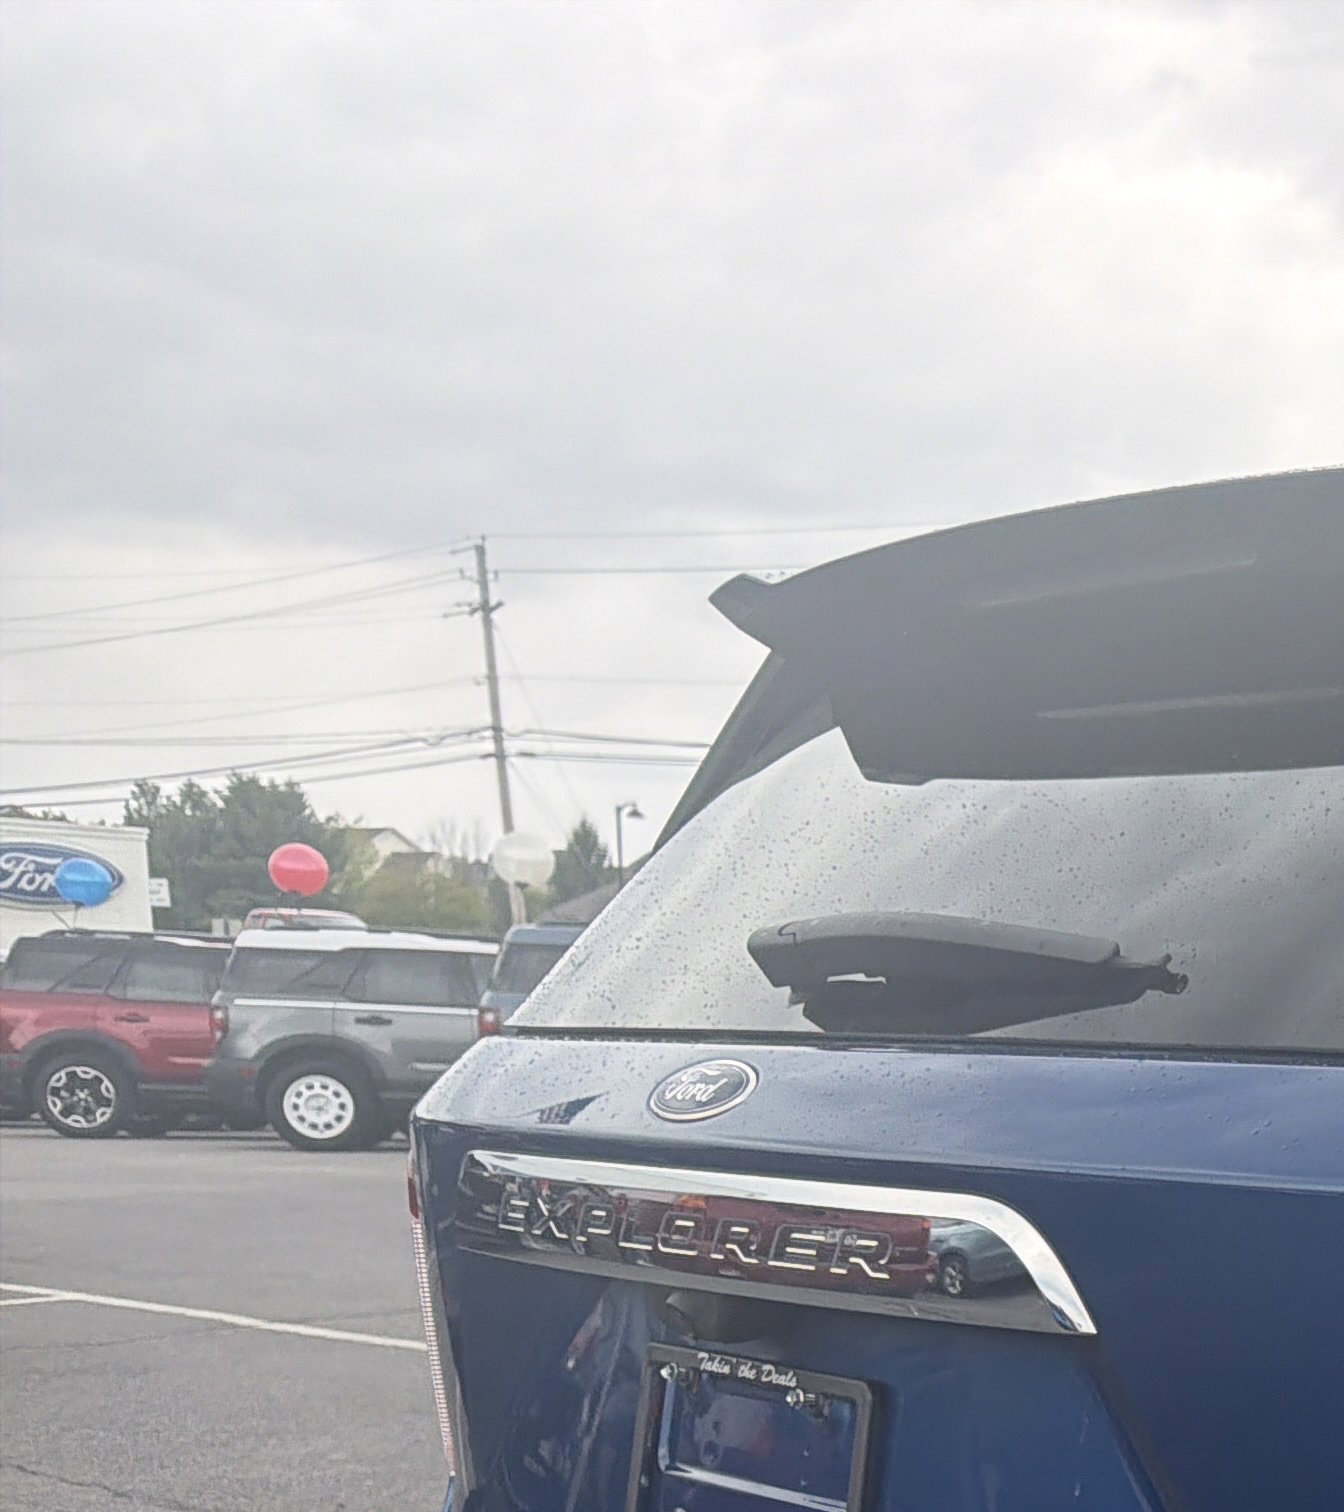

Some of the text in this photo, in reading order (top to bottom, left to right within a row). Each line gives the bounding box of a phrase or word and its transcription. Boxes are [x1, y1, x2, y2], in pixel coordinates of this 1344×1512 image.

[0, 852, 63, 892] For
[664, 1067, 729, 1103] Ford
[498, 1190, 893, 1280] EXPLORER
[737, 1360, 757, 1380] the
[761, 1363, 797, 1387] Deals
